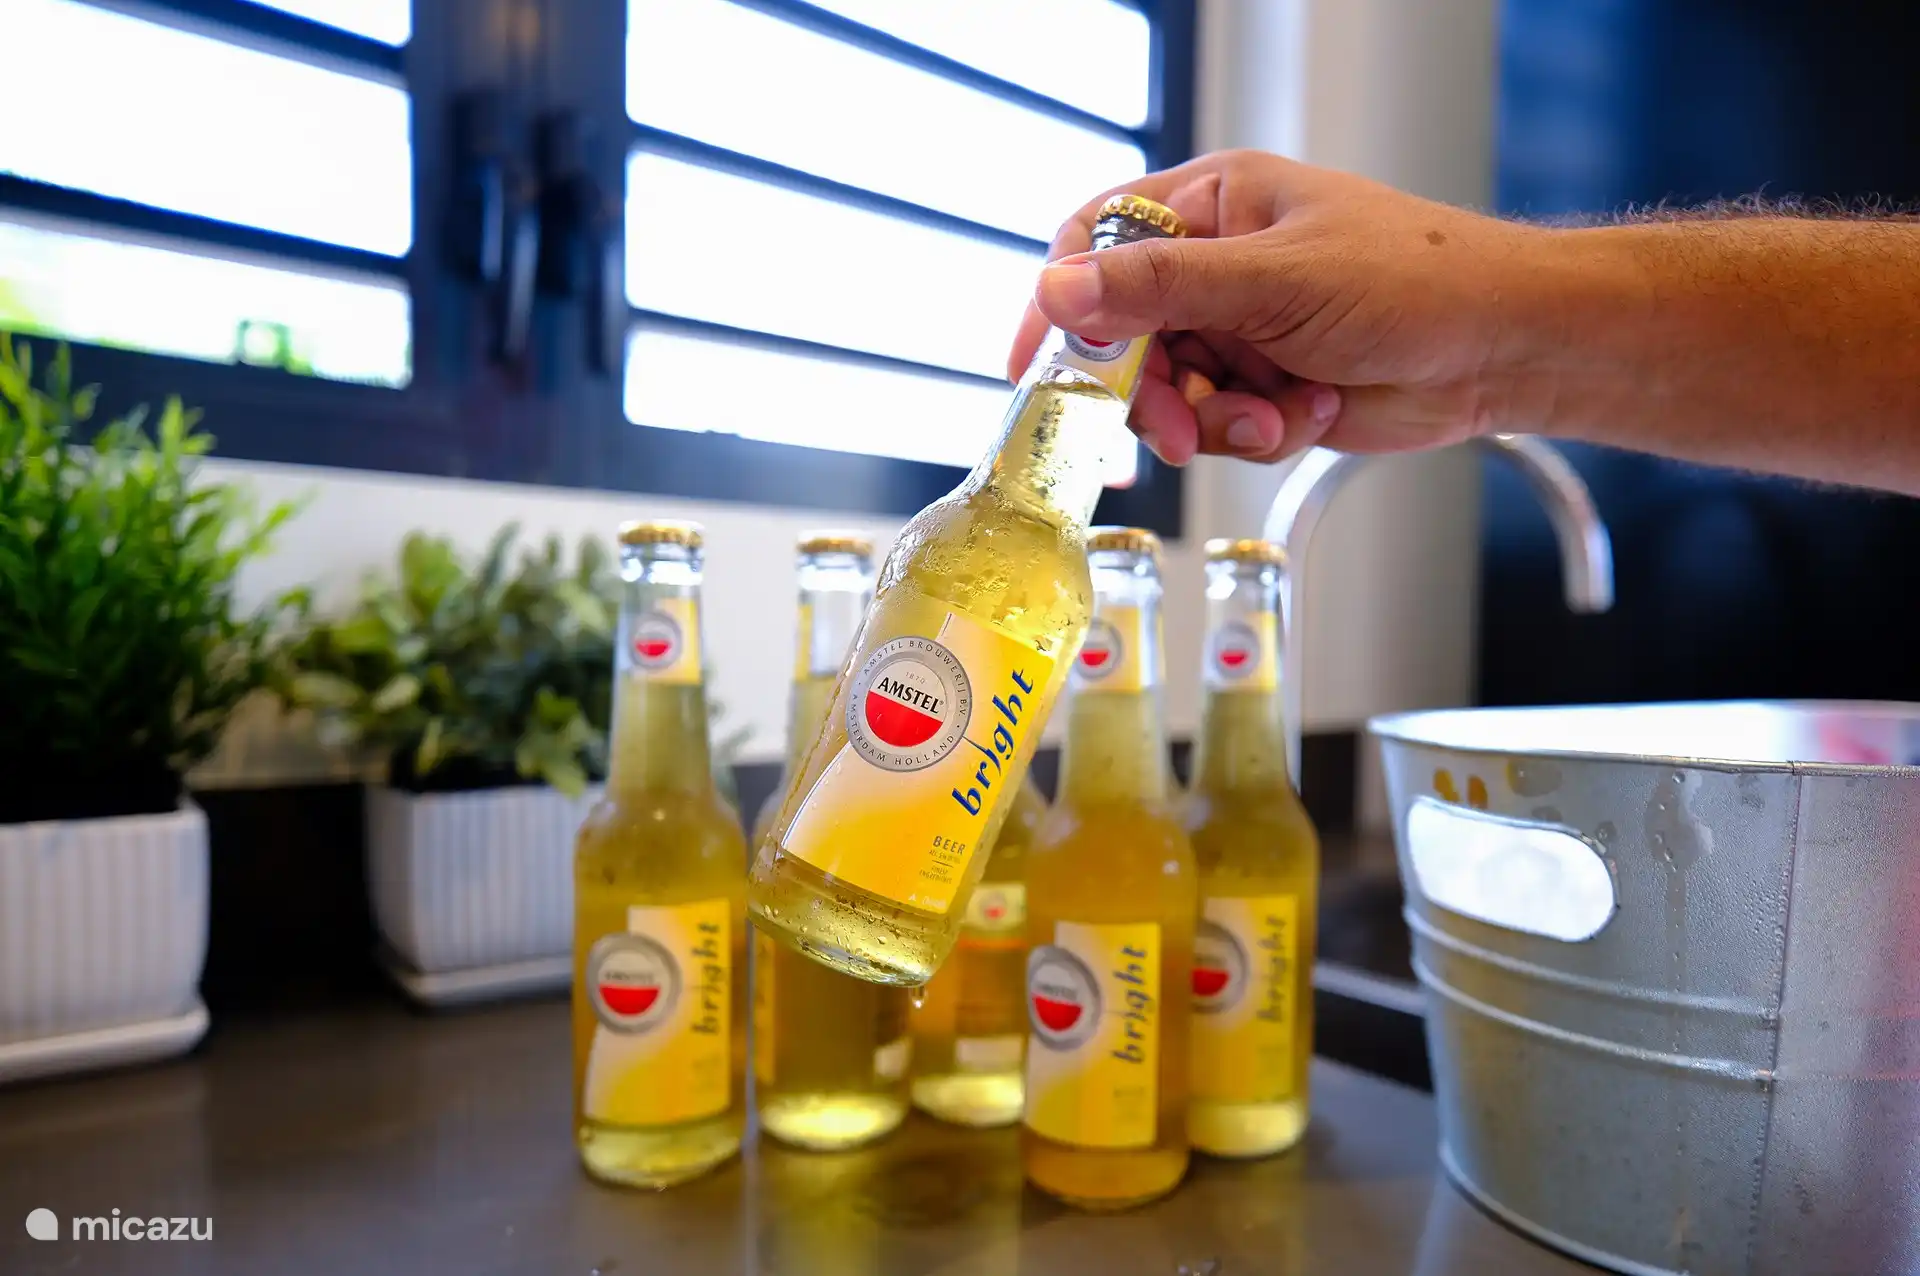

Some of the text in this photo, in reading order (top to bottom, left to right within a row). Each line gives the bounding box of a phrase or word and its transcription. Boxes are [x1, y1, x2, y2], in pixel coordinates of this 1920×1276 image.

[863, 640, 903, 676] AMSTEL
[908, 640, 967, 693] BROUWERIJ
[905, 671, 926, 685] 1870
[849, 693, 955, 766] AMSTERDAM HOLLAND
[951, 668, 1034, 816] bright
[932, 835, 966, 855] BEER
[1112, 944, 1151, 1064] bright
